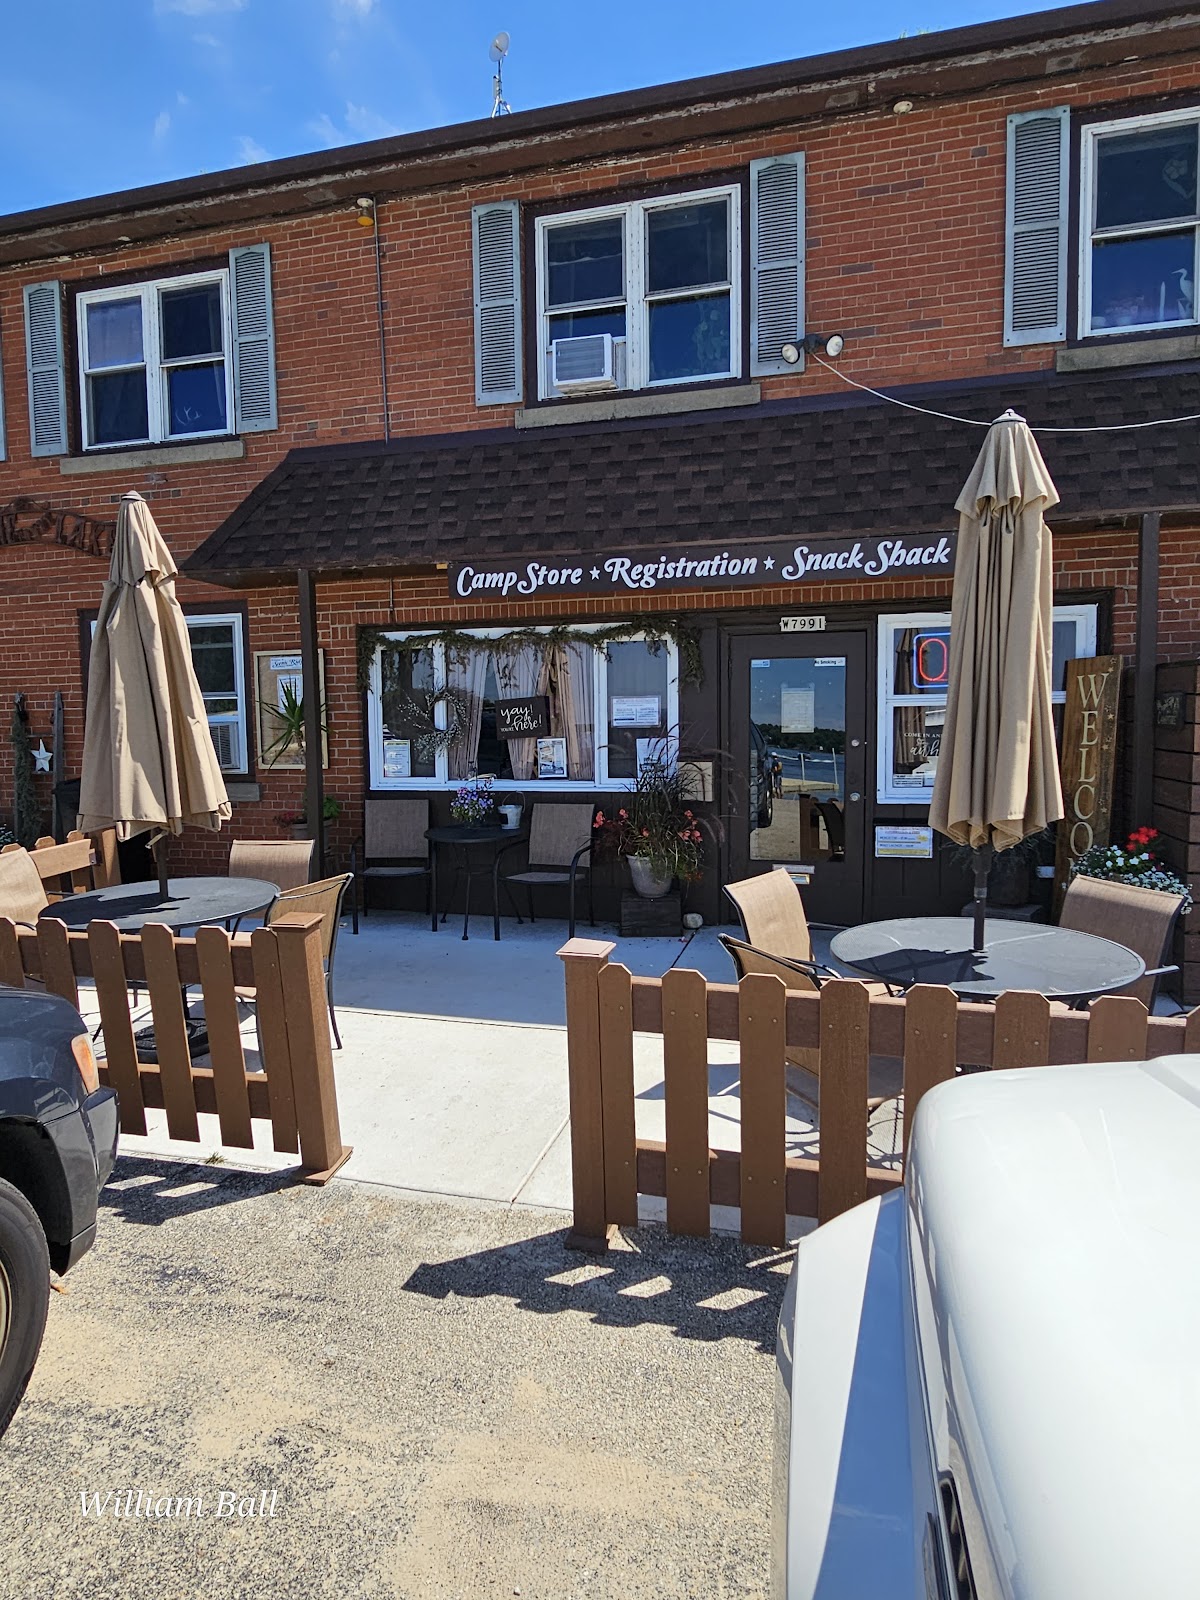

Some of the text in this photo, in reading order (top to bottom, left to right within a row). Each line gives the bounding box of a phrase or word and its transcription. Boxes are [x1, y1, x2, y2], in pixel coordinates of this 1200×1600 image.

[456, 537, 951, 597] Camp Store Registration Snack Shack
[782, 618, 824, 630] W7991
[500, 704, 534, 724] yay!
[511, 714, 542, 731] here!
